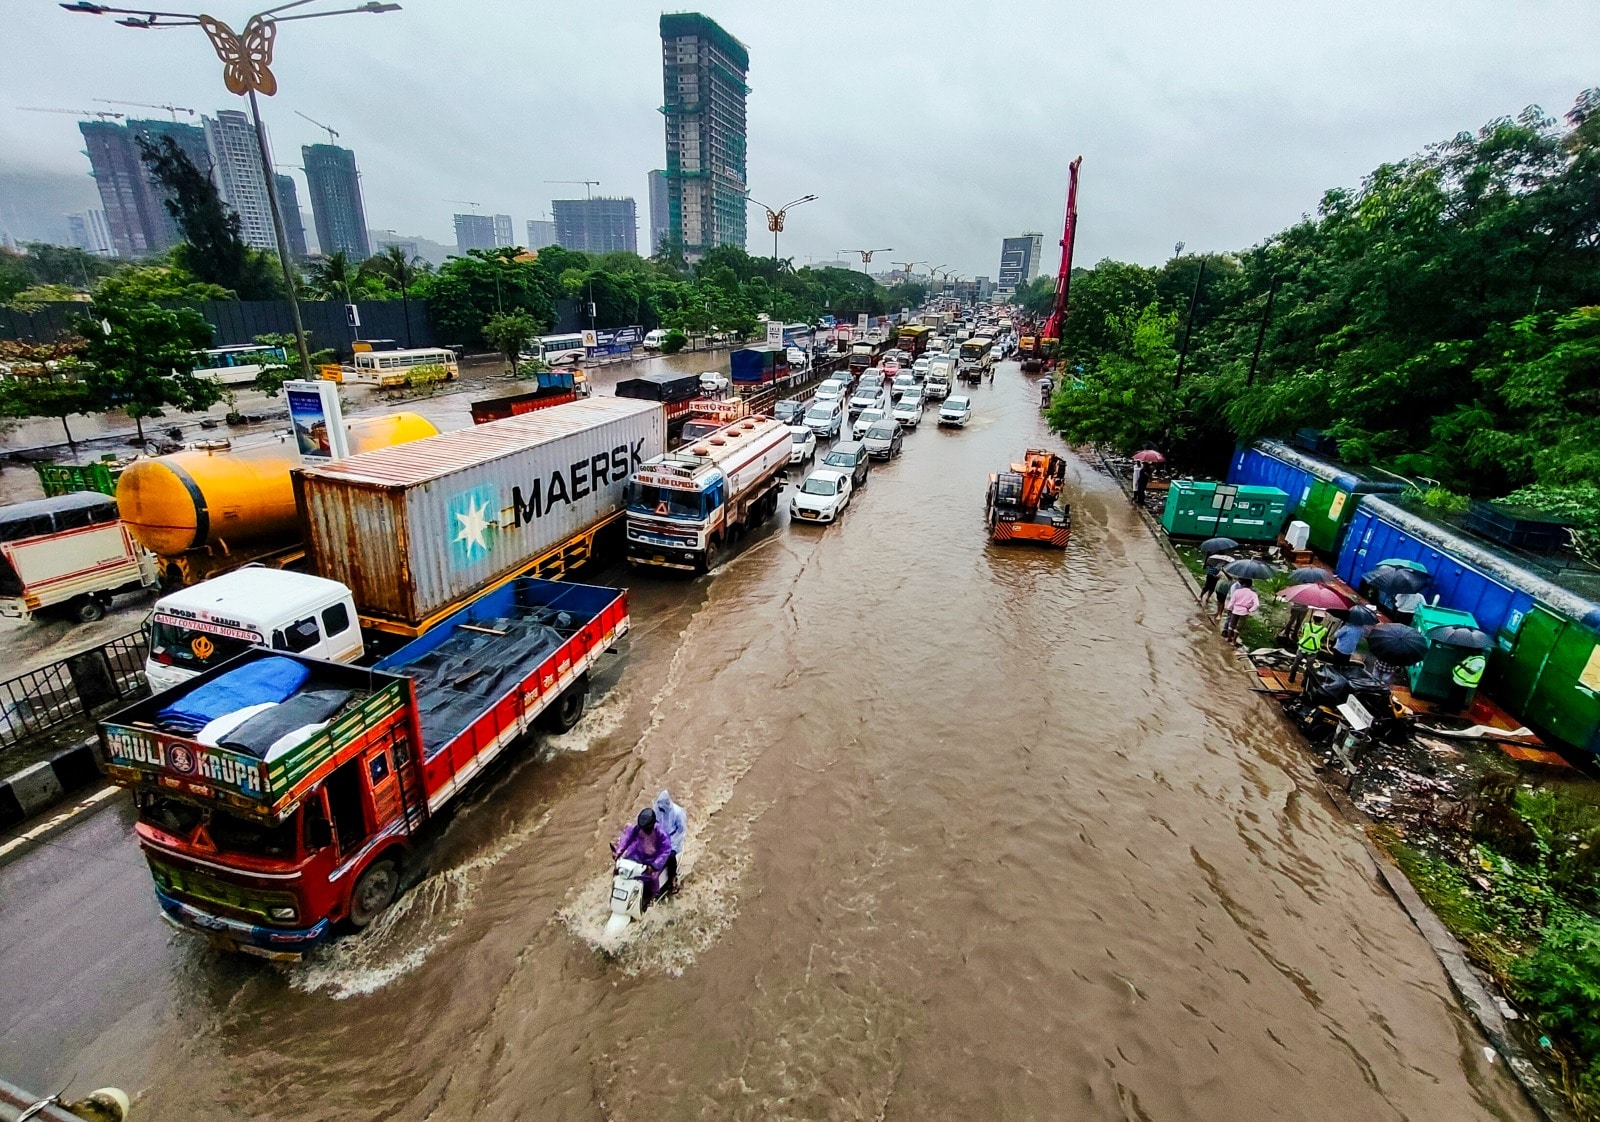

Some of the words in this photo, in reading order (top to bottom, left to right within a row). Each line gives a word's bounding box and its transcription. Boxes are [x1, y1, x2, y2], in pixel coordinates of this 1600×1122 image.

[512, 437, 645, 528] MAERSK
[178, 620, 219, 633] CONTAINER
[219, 627, 252, 640] MOVERS
[107, 733, 166, 767] MAULI
[196, 750, 261, 793] KRUPA
